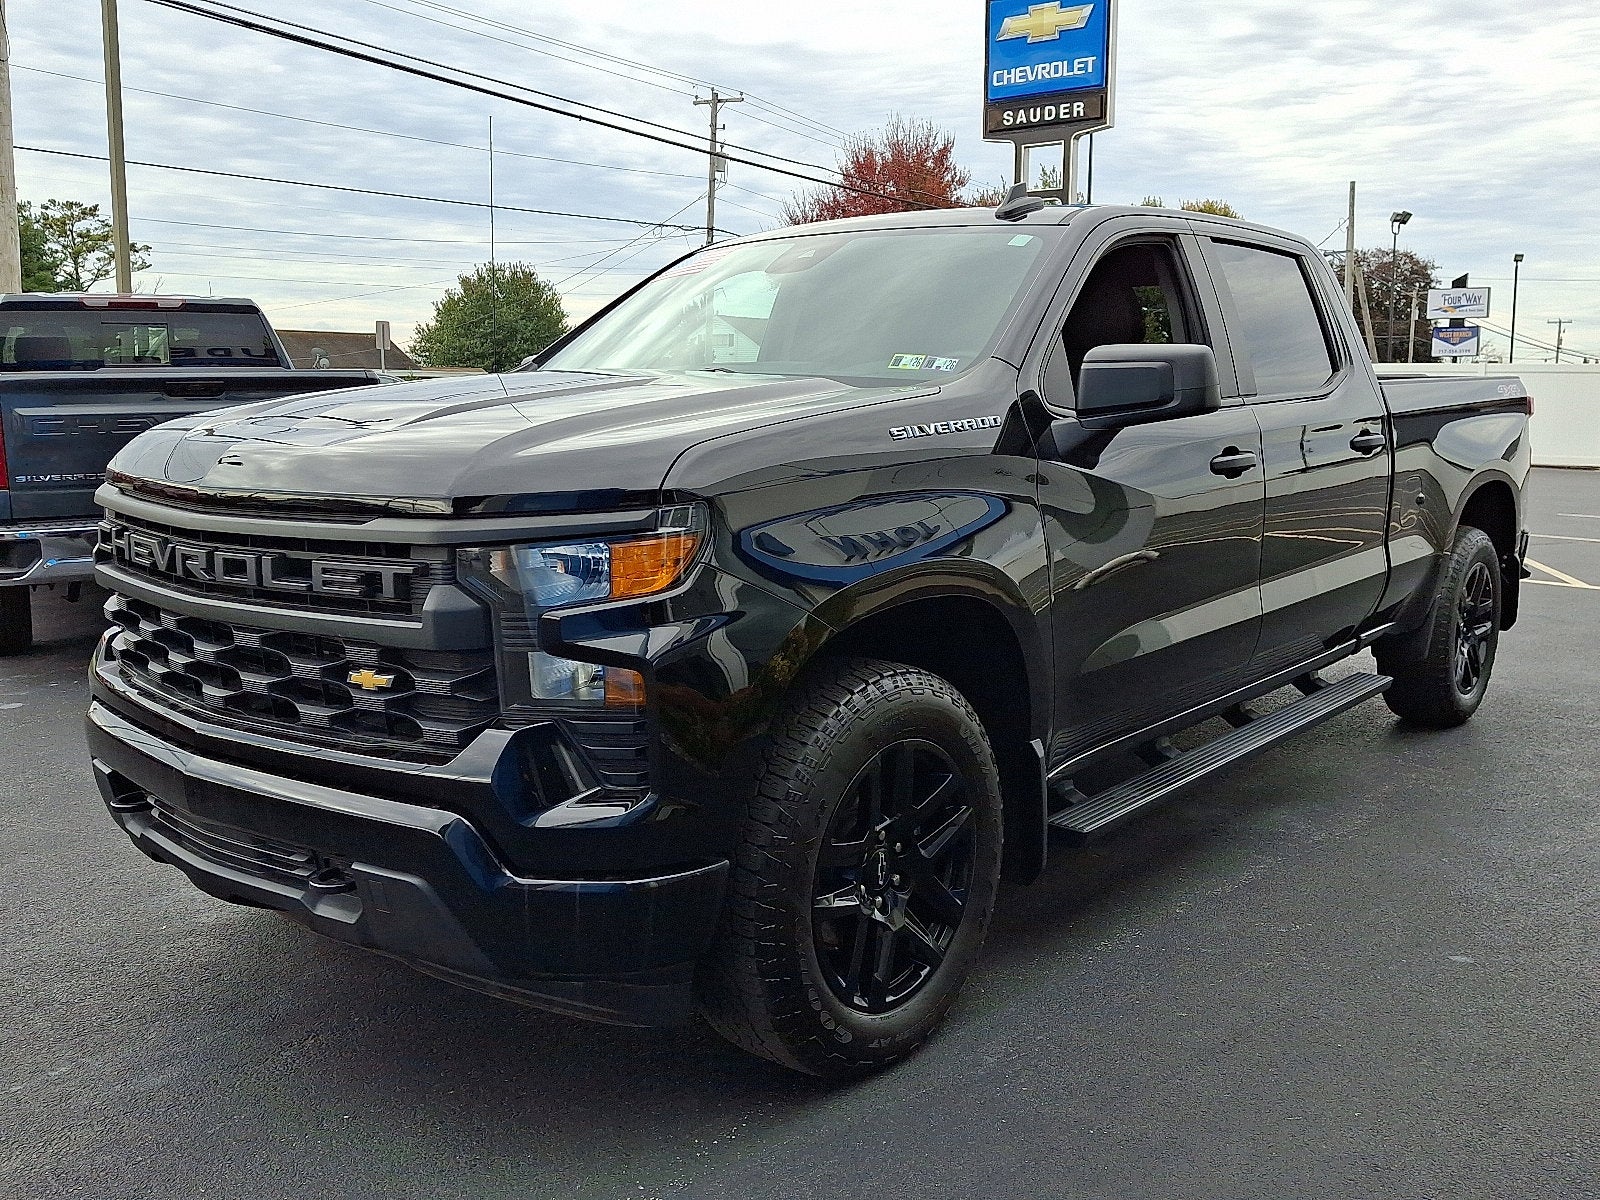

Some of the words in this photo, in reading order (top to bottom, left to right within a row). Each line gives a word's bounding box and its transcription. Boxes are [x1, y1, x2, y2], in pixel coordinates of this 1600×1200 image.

[992, 56, 1097, 87] CHEVROLET
[1002, 102, 1085, 126] SAUDER
[888, 415, 1002, 441] SILVERADO
[98, 520, 429, 598] CHEVROLET
